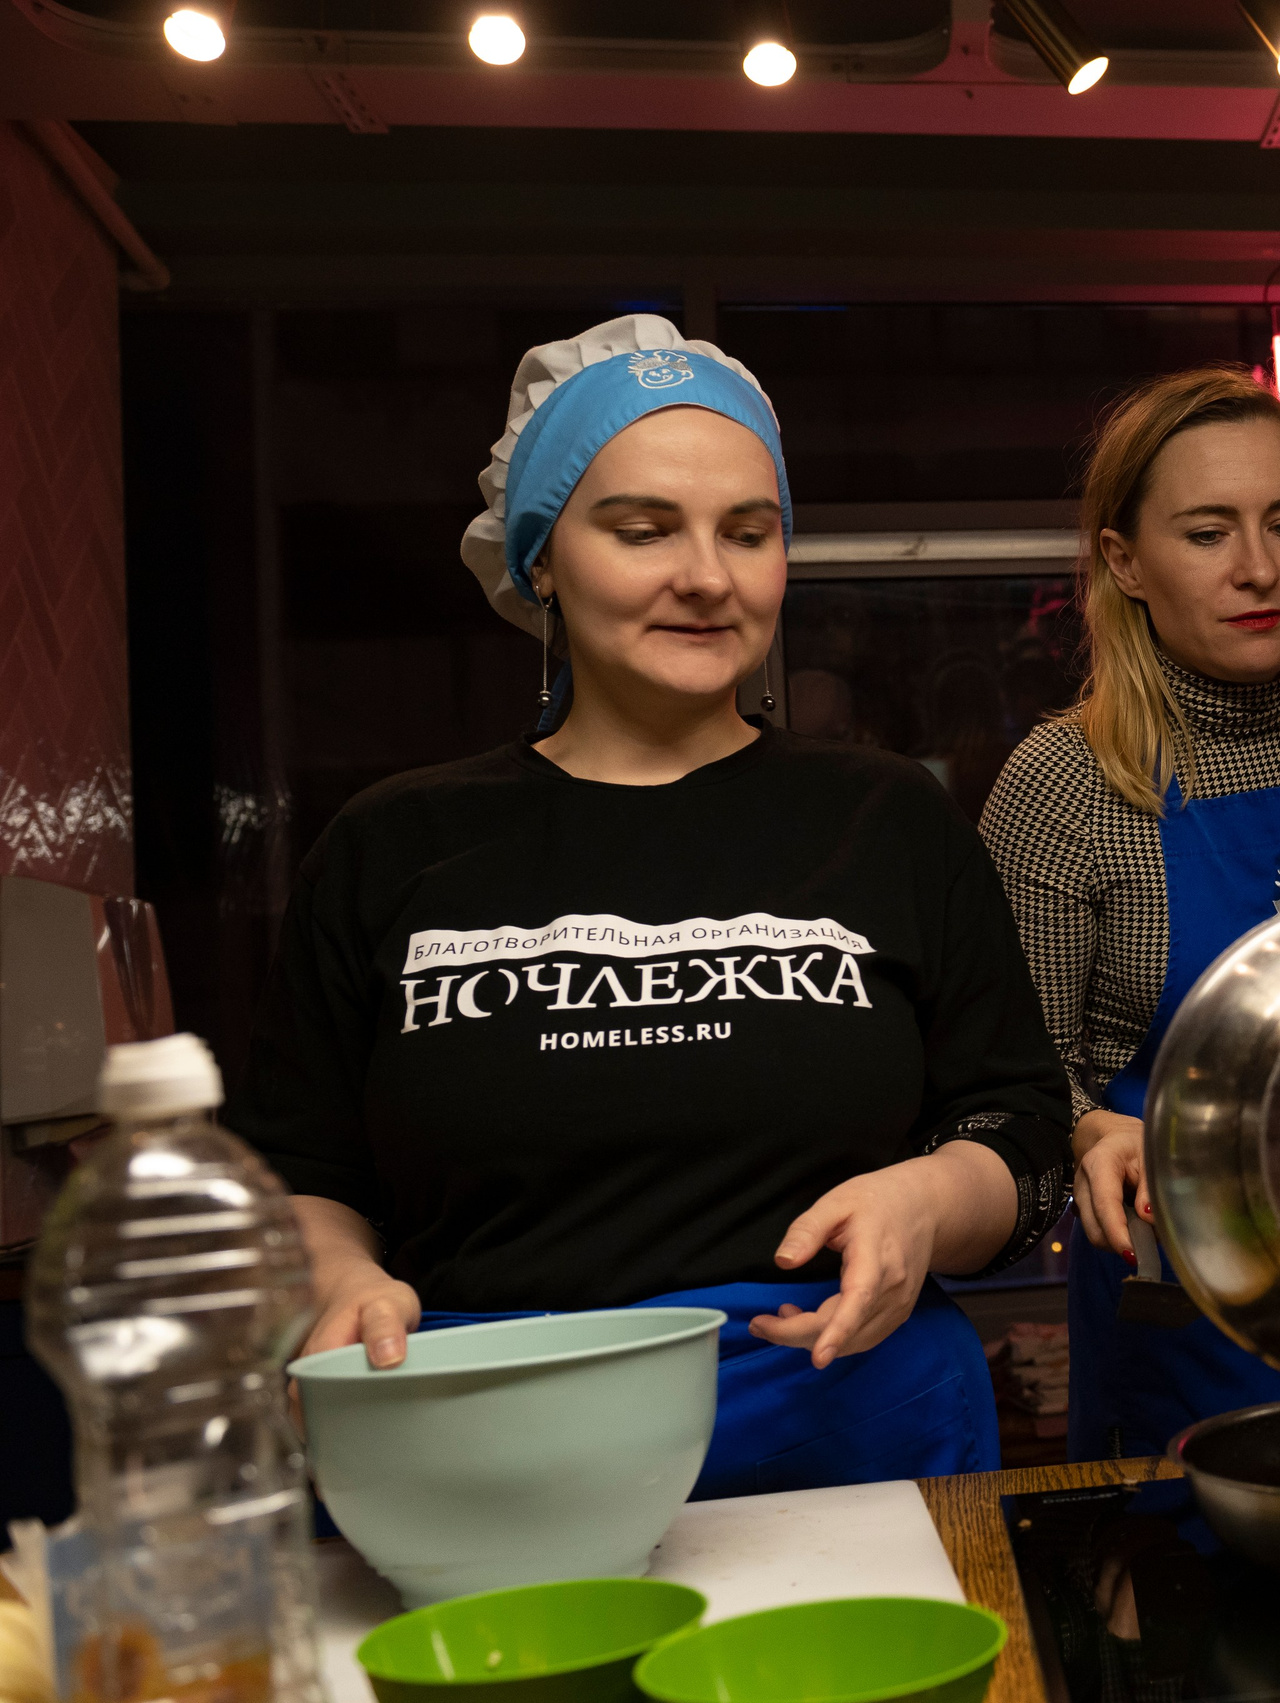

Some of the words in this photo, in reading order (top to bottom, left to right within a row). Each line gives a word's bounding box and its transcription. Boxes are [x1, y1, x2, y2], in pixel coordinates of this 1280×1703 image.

[414, 926, 681, 960] БЛАГОТВОРИТЕЛЬНАЯ
[691, 923, 863, 950] ОРГАНИЗАЦИЯ
[399, 952, 873, 1034] НОЧЛЕЖКА
[540, 1021, 732, 1050] HOMELESS.RU
